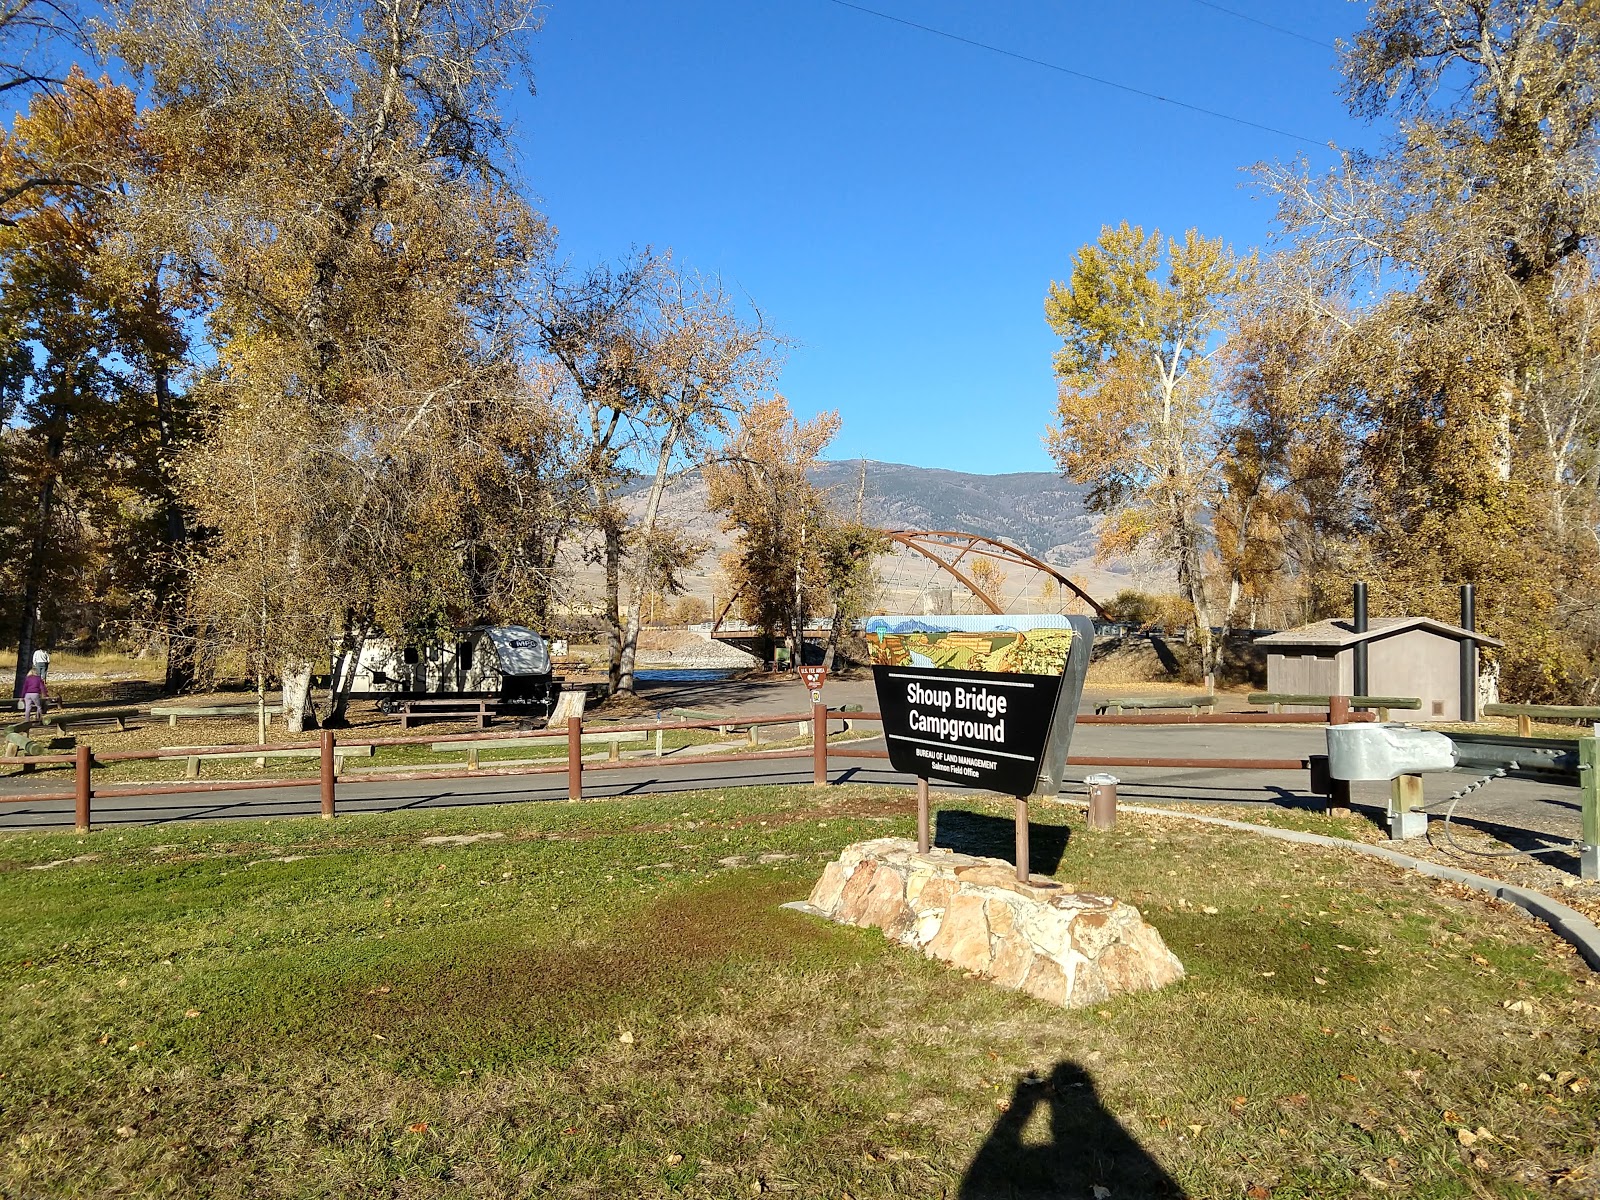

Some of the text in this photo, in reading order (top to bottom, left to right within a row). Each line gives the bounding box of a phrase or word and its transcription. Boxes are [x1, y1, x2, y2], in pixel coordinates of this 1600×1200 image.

[907, 682, 1007, 718] Shoup Bridge
[909, 709, 1004, 743] Campground
[916, 748, 997, 770] BUREAU OF LAND MANAGEMENT
[932, 762, 979, 778] Salmon Field Office
